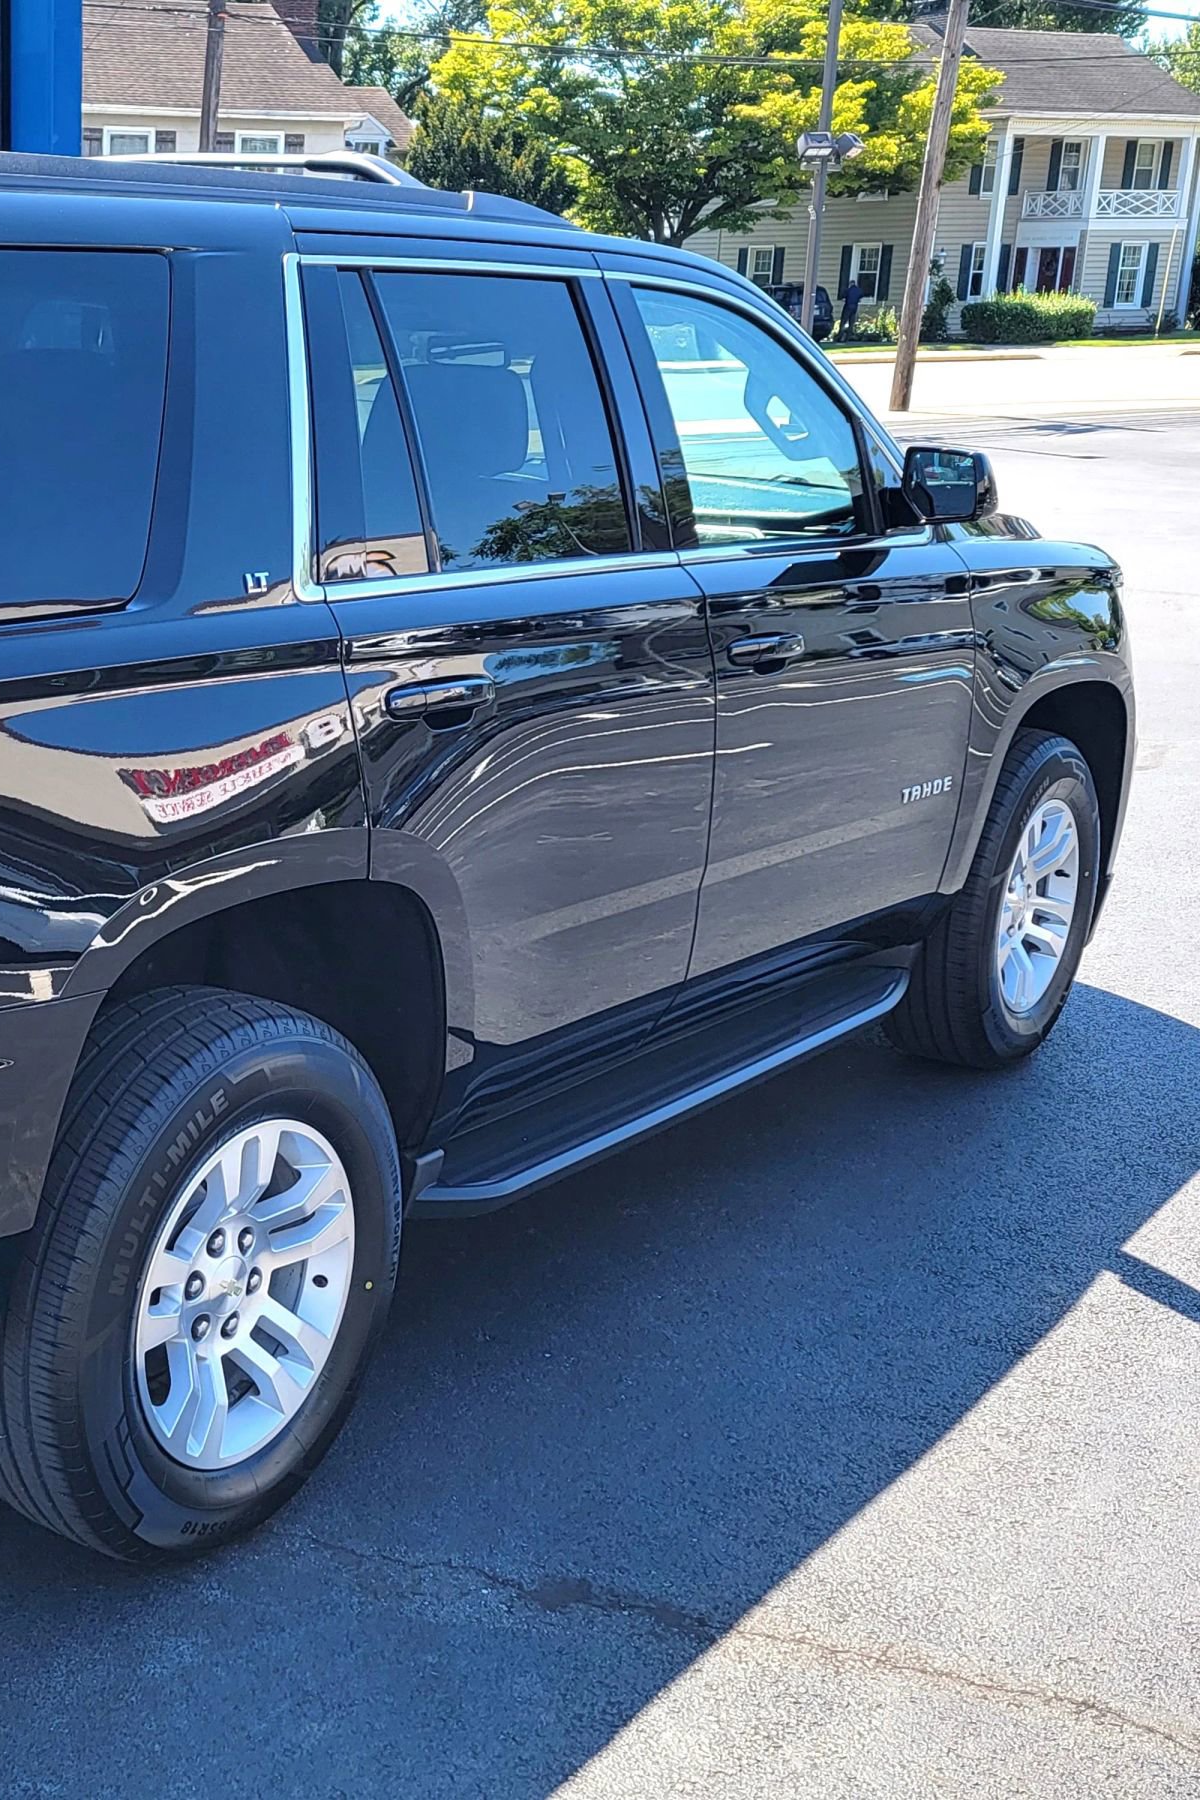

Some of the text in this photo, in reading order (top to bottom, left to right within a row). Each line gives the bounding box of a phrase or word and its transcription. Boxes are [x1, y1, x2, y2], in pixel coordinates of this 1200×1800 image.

[243, 571, 269, 594] LT
[901, 775, 953, 804] TAHOE
[108, 1088, 230, 1297] MULTI-MILE
